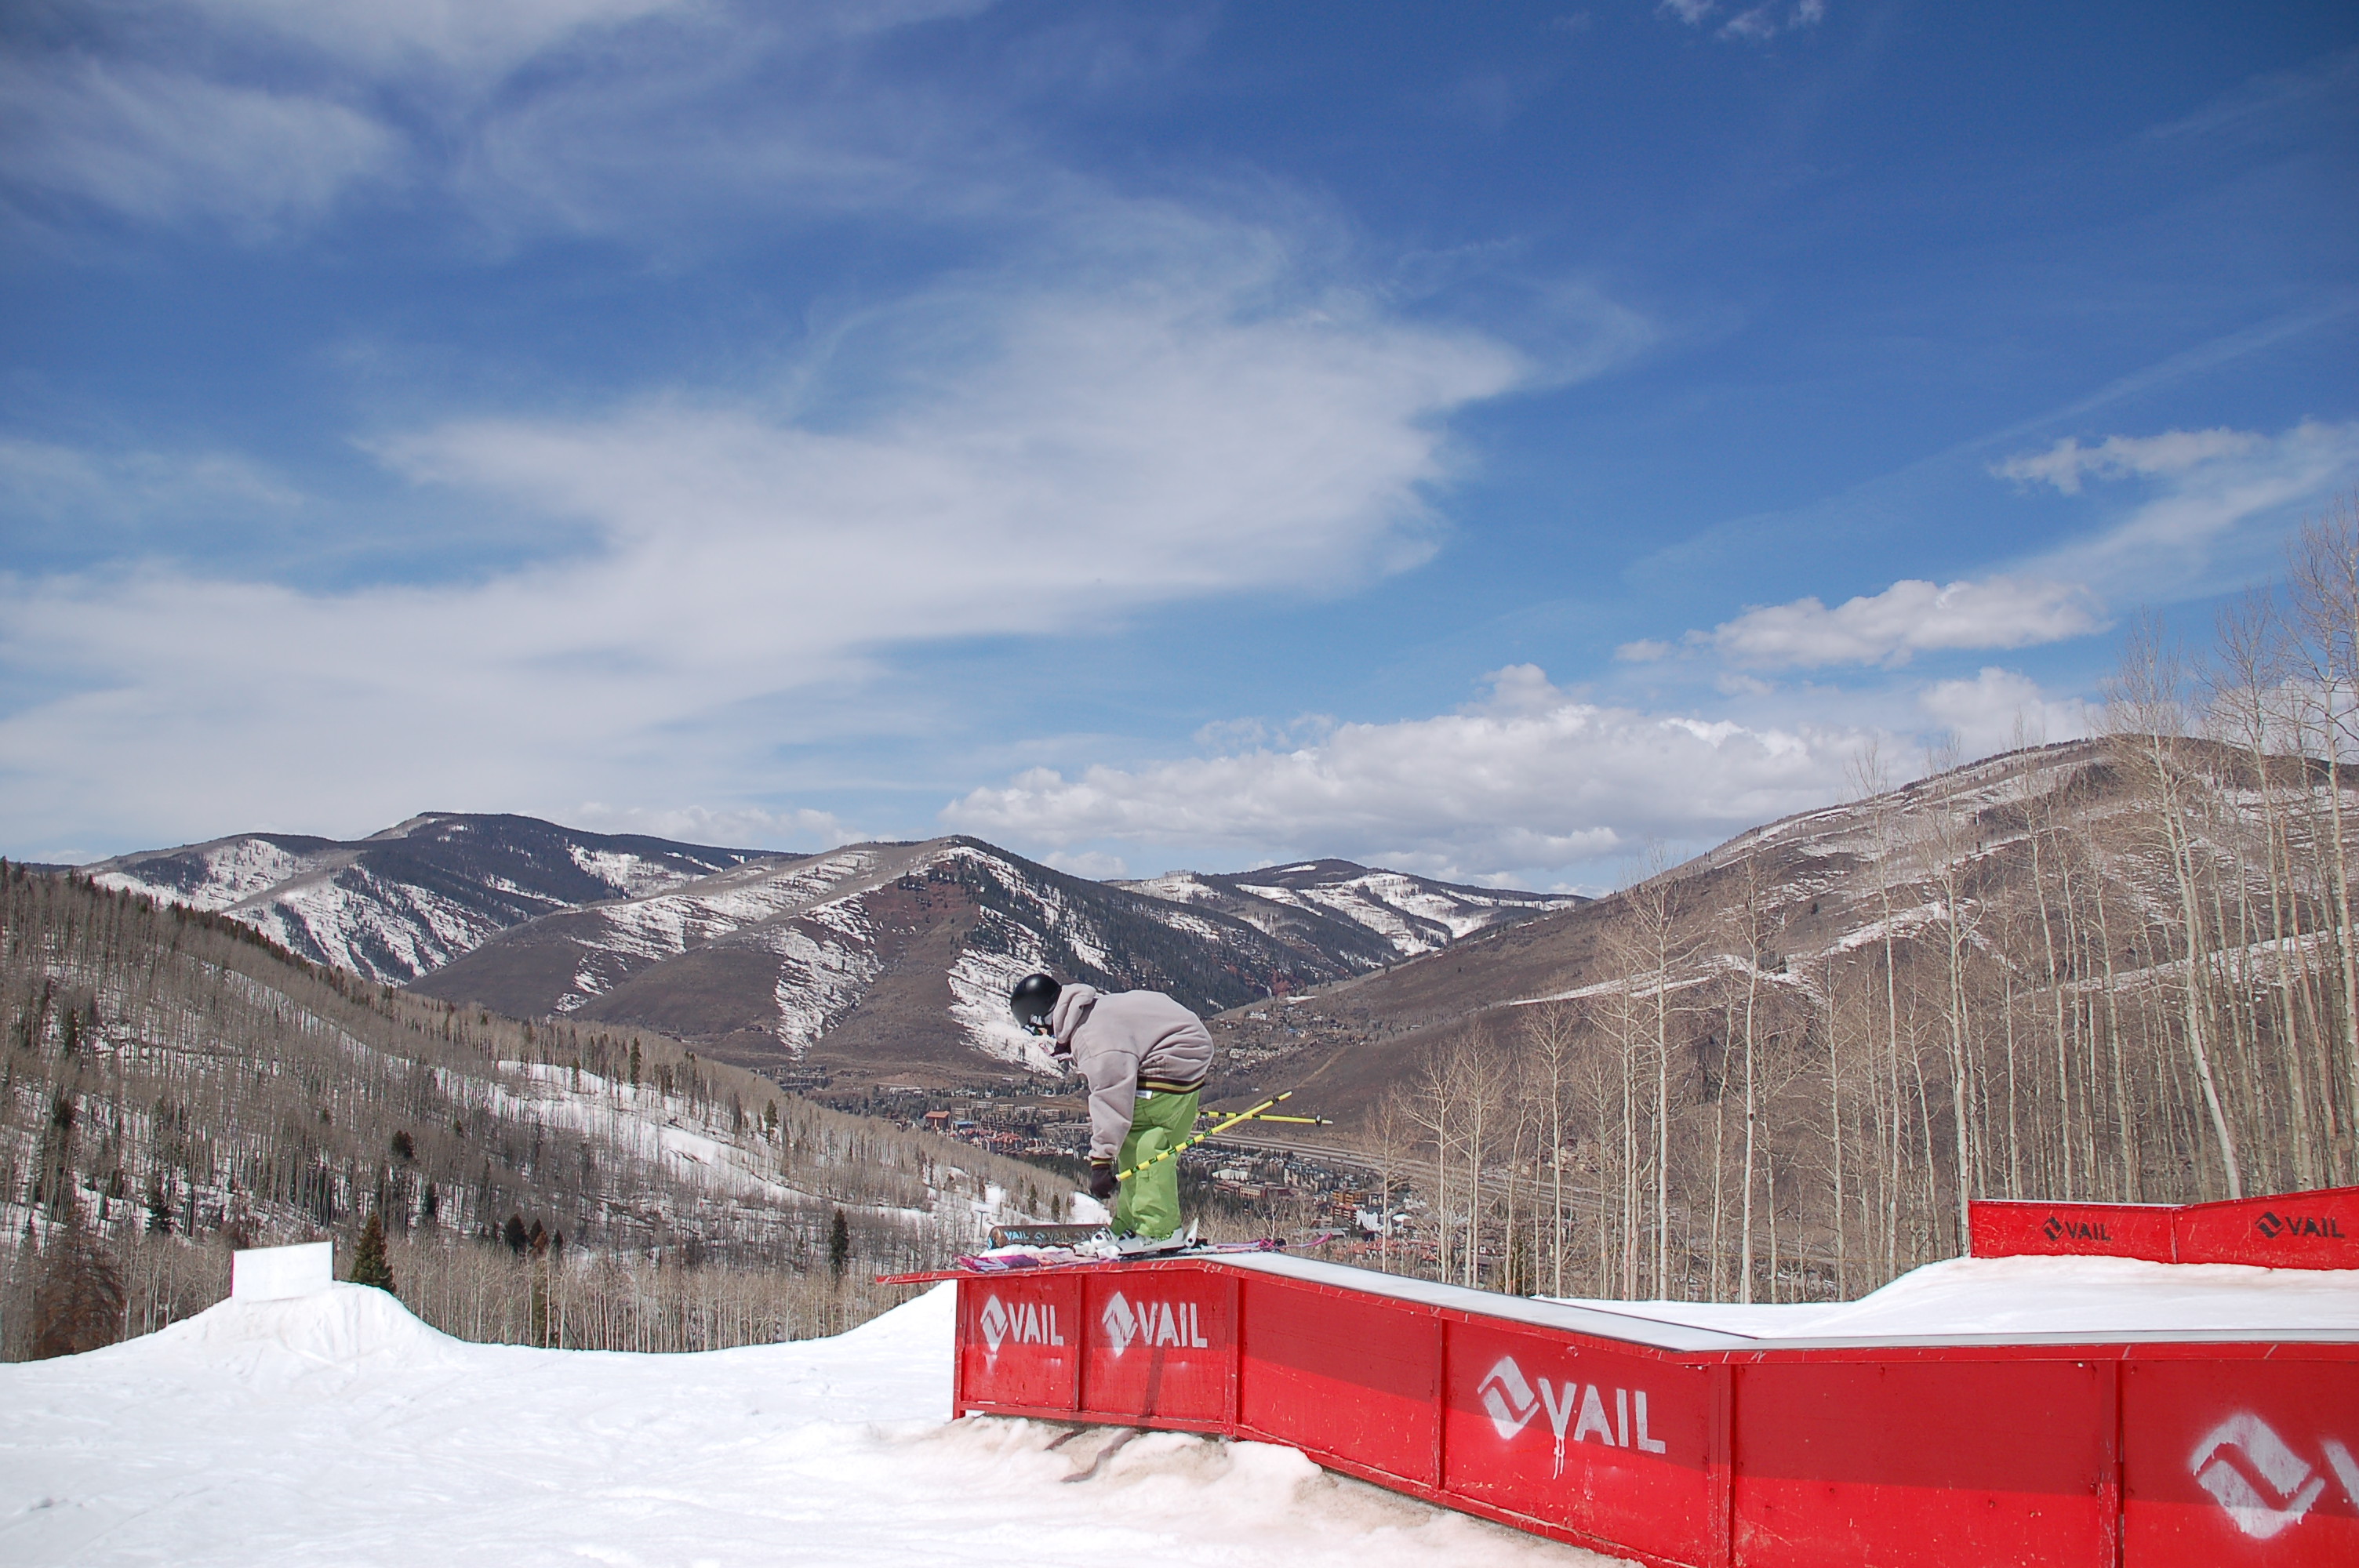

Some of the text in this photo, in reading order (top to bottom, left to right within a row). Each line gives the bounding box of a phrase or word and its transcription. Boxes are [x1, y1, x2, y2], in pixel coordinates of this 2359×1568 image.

[1003, 1230, 1030, 1241] VAIL
[2065, 1221, 2112, 1240] VAIL
[2284, 1216, 2346, 1239] VAIL
[1007, 1301, 1064, 1347] VAIL
[1136, 1301, 1208, 1348] VAIL
[1537, 1377, 1667, 1454] VAIL
